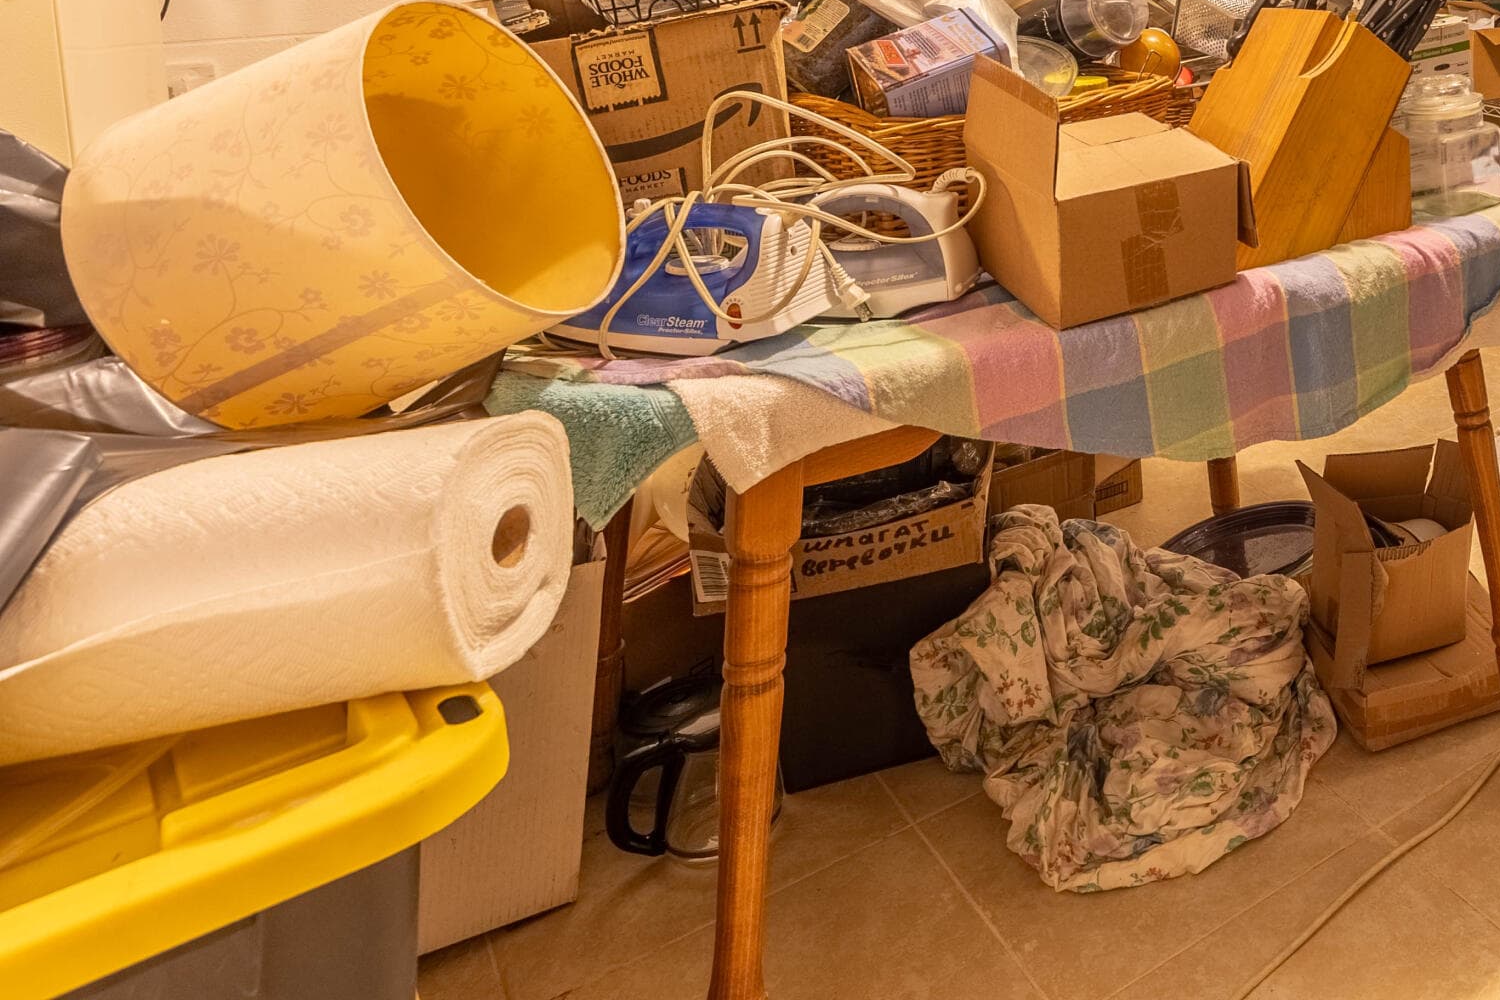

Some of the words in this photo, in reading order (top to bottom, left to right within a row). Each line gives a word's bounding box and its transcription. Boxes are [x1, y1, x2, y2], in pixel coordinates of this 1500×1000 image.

[595, 49, 636, 61] MARKET
[588, 55, 644, 76] FOODS
[589, 67, 650, 89] WHOLE
[619, 169, 671, 187] FOODS
[625, 182, 665, 193] MARKET
[637, 314, 705, 328] ClearSteam
